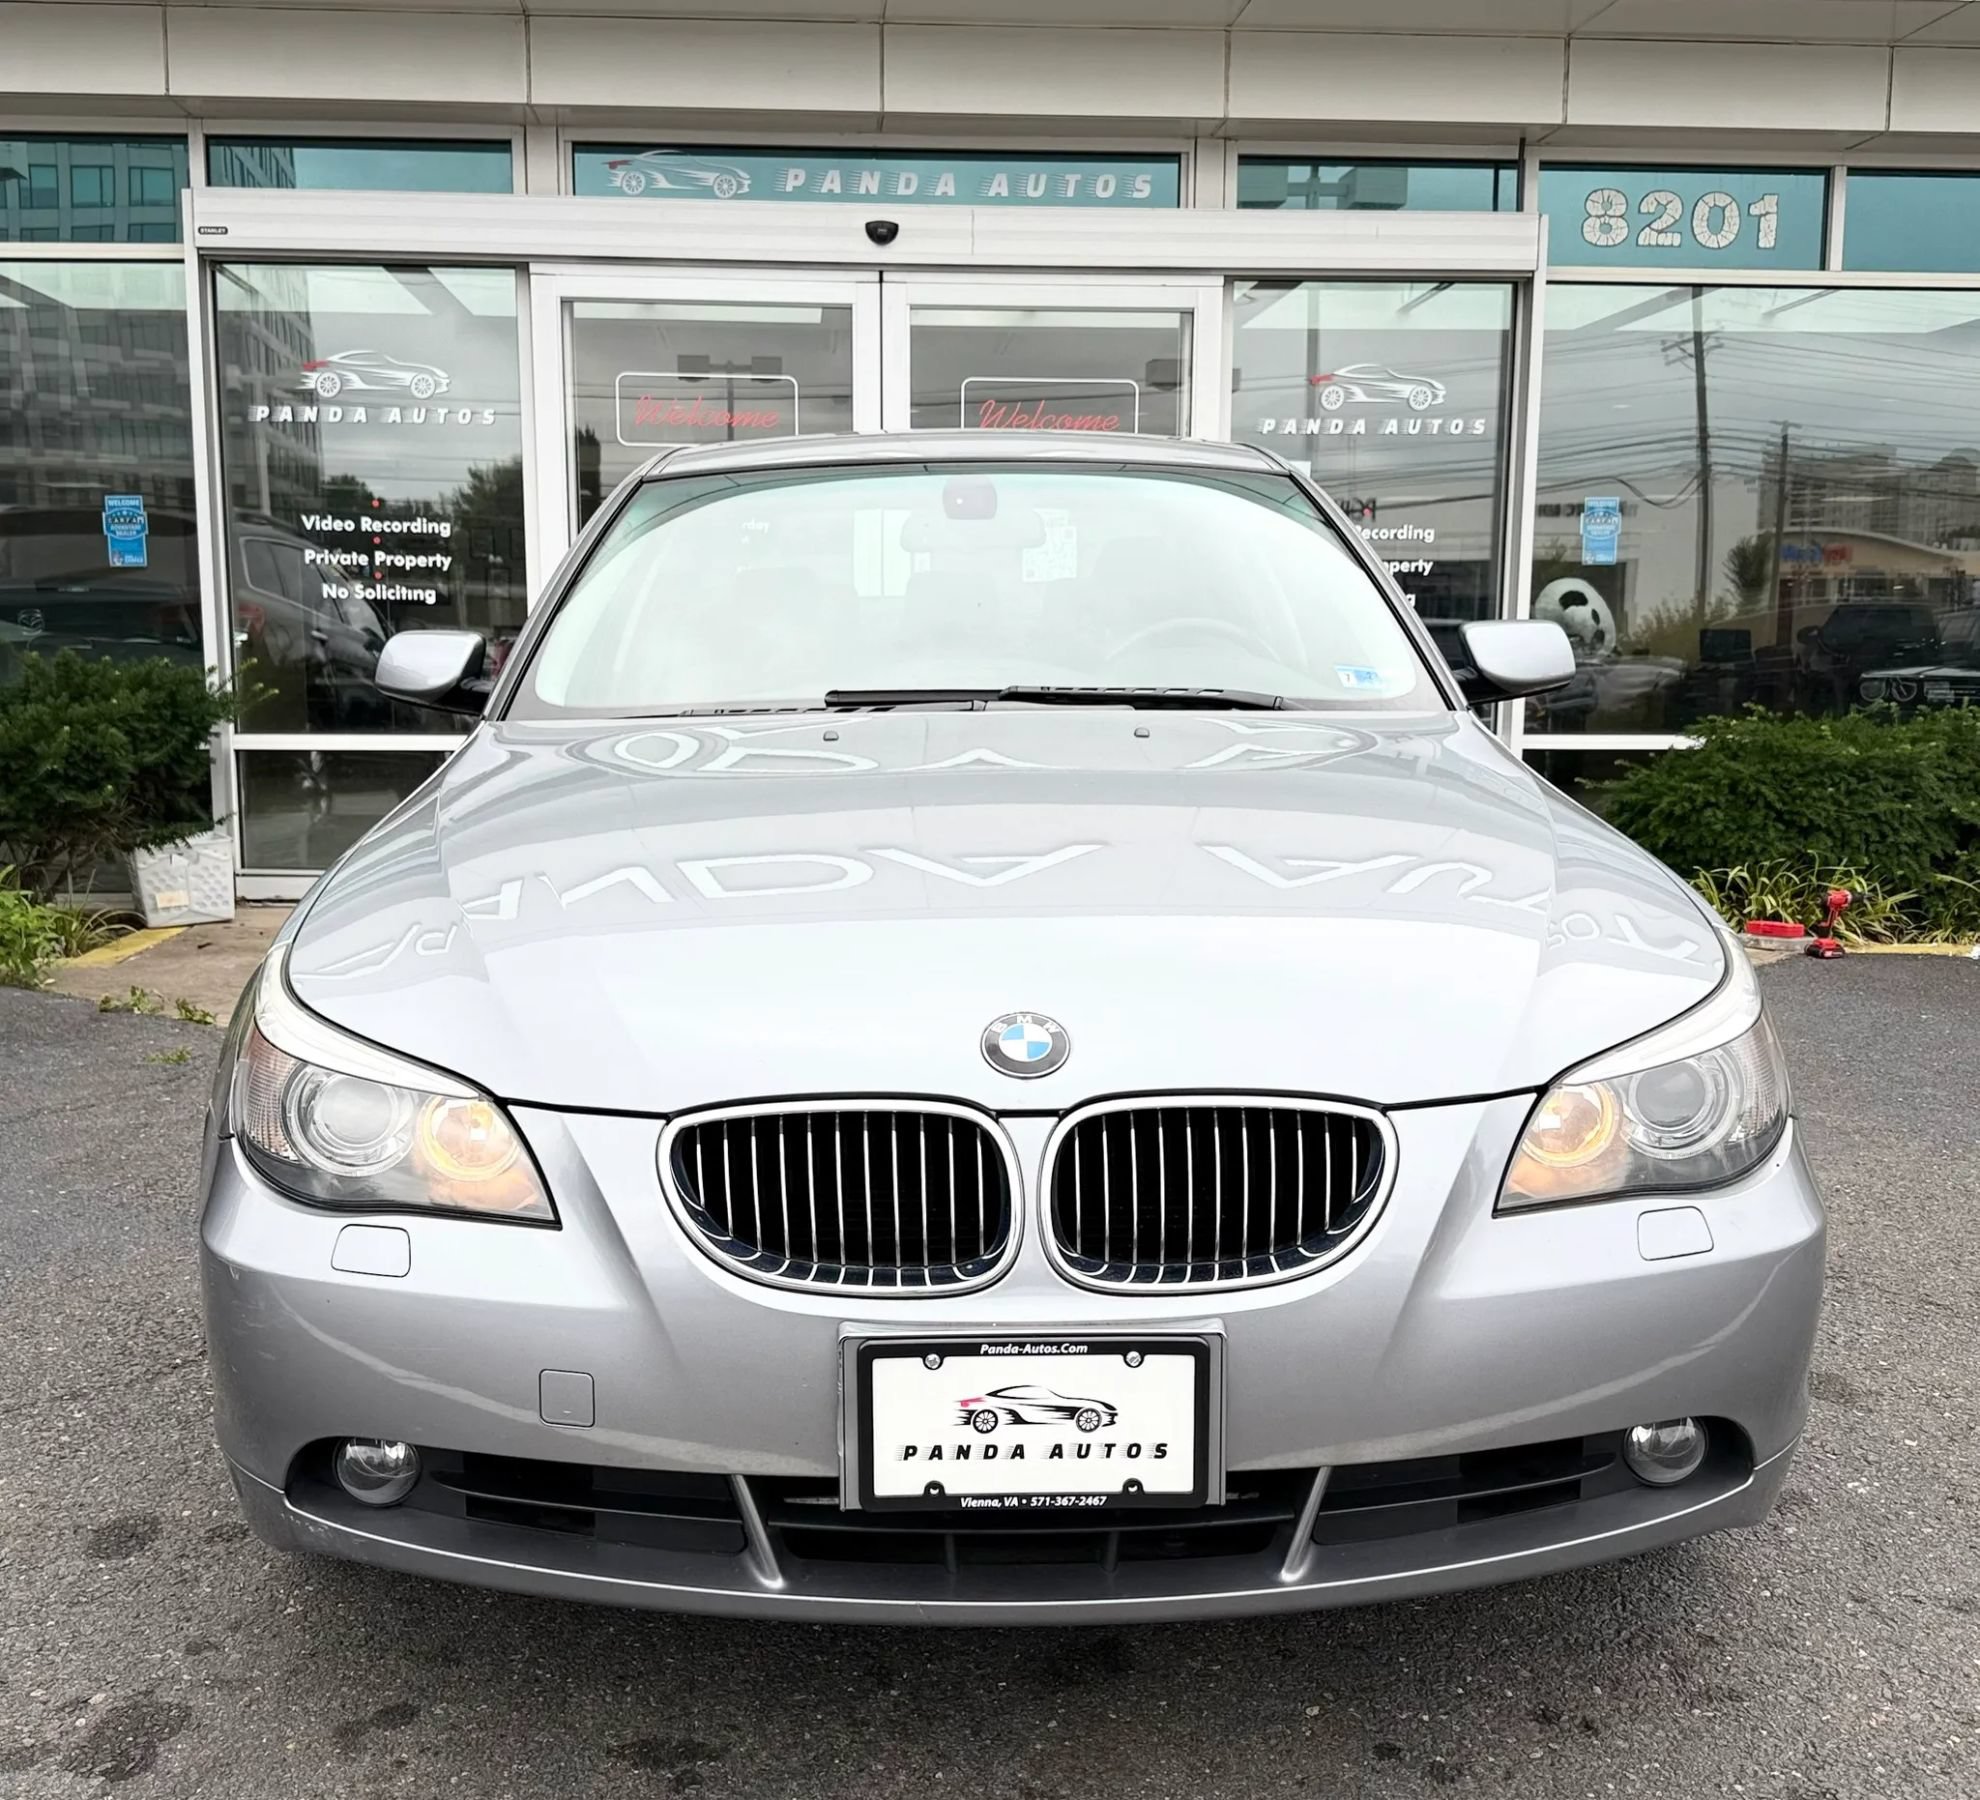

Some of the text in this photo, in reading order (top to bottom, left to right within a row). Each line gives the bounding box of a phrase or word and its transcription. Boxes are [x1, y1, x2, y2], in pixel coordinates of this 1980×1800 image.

[779, 168, 1153, 199] PANDA AUTOS
[1581, 188, 1779, 250] 8201
[252, 405, 496, 426] PANDA AUTOS
[634, 391, 782, 430] Welcome
[979, 399, 1121, 431] Welcome
[1259, 418, 1486, 435] PANDA AUTOS
[301, 515, 452, 538] Video Recording
[304, 549, 453, 572] Private Property
[322, 583, 349, 600] No
[990, 1015, 1061, 1034] BMW
[980, 1343, 1089, 1356] Panda-Autos.Com
[899, 1442, 1168, 1461] PANDA AUTOS
[960, 1496, 1107, 1509] Vienna, VA 571-367-2467
